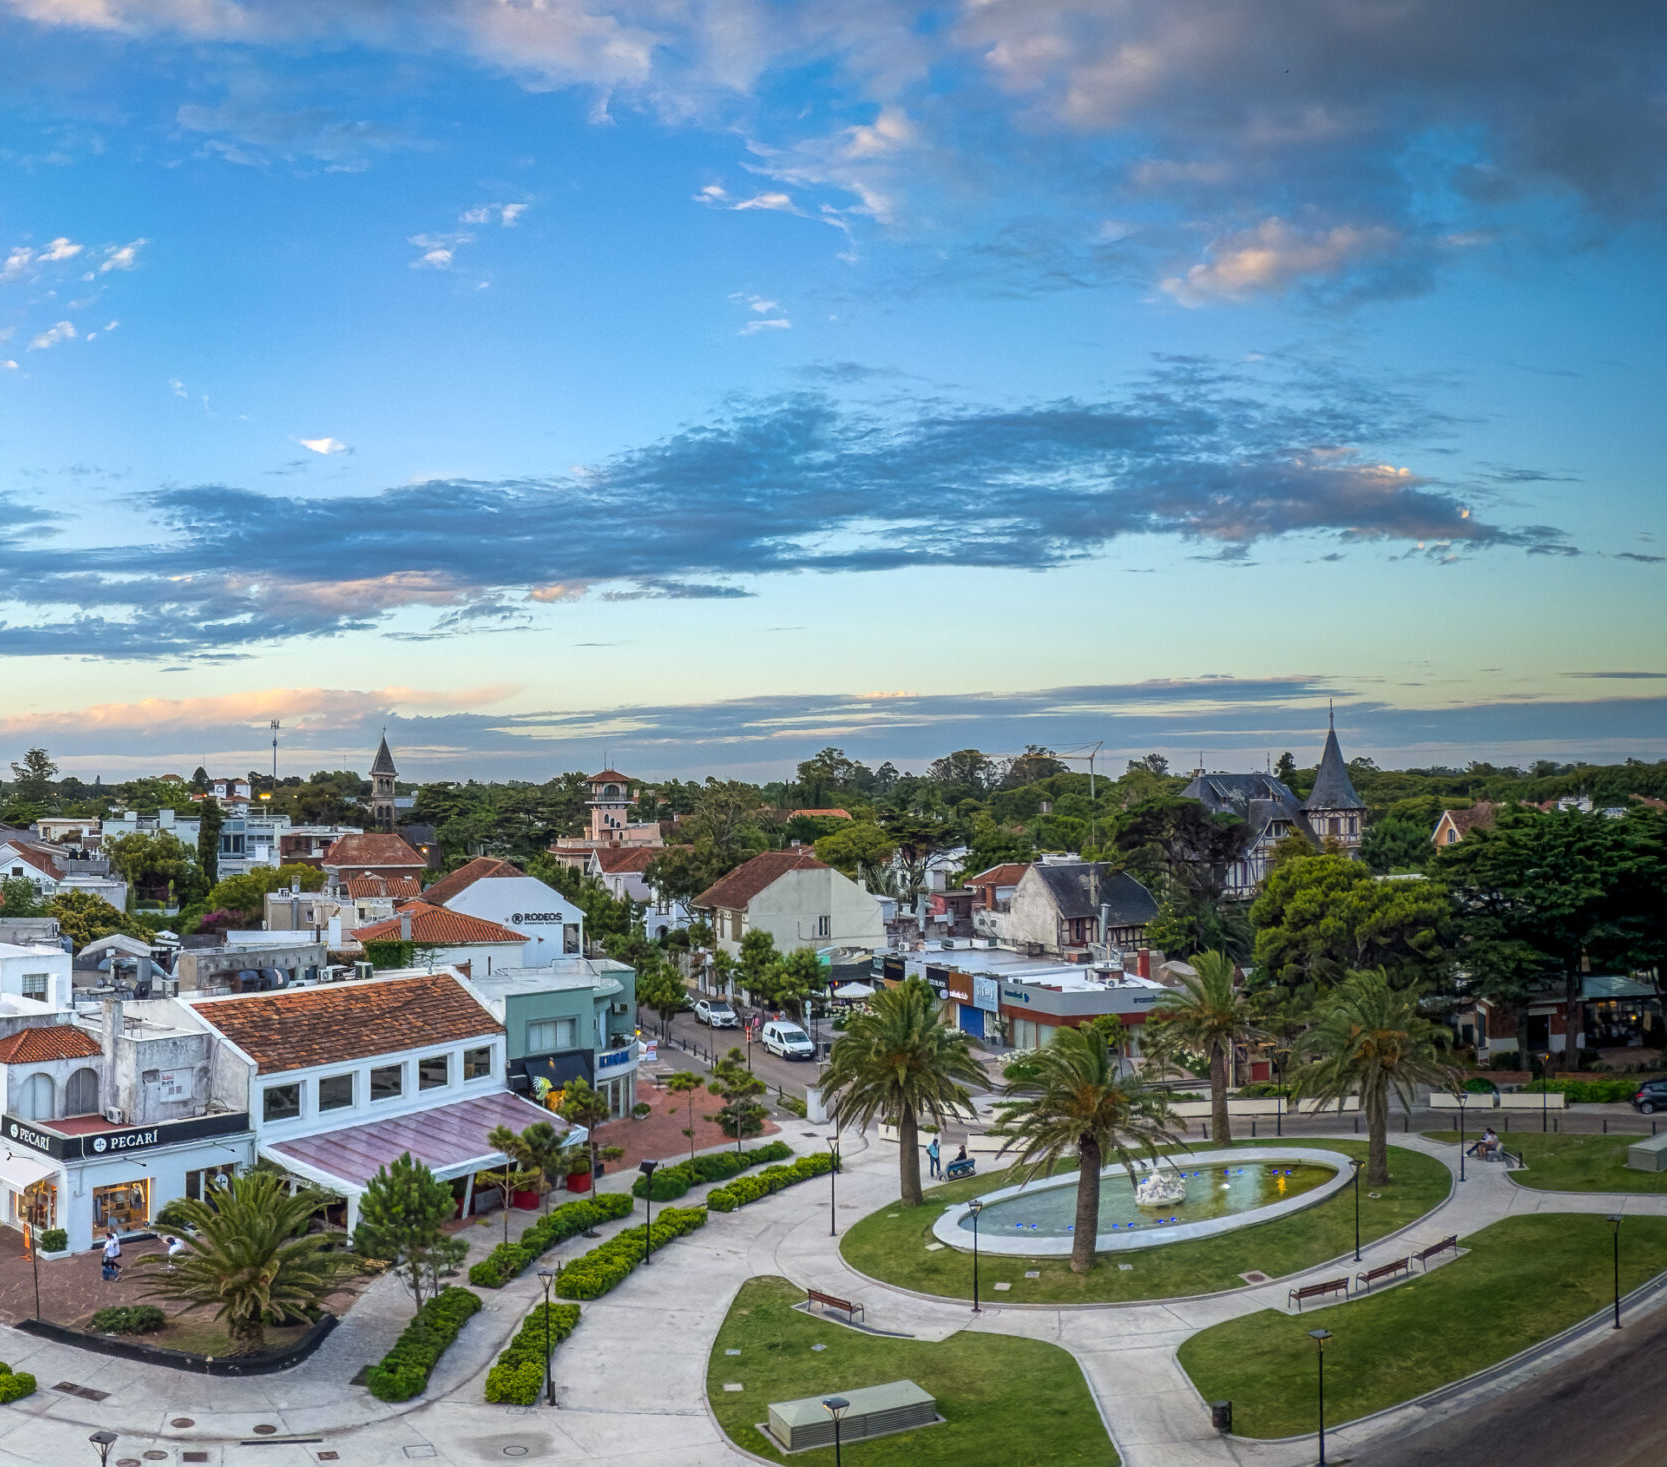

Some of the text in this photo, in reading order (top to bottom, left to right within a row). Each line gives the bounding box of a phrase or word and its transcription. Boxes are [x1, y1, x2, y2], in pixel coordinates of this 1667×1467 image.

[524, 912, 562, 921] RODEOS
[19, 1127, 51, 1151] PECARÍ
[110, 1128, 159, 1150] PECARÍ
